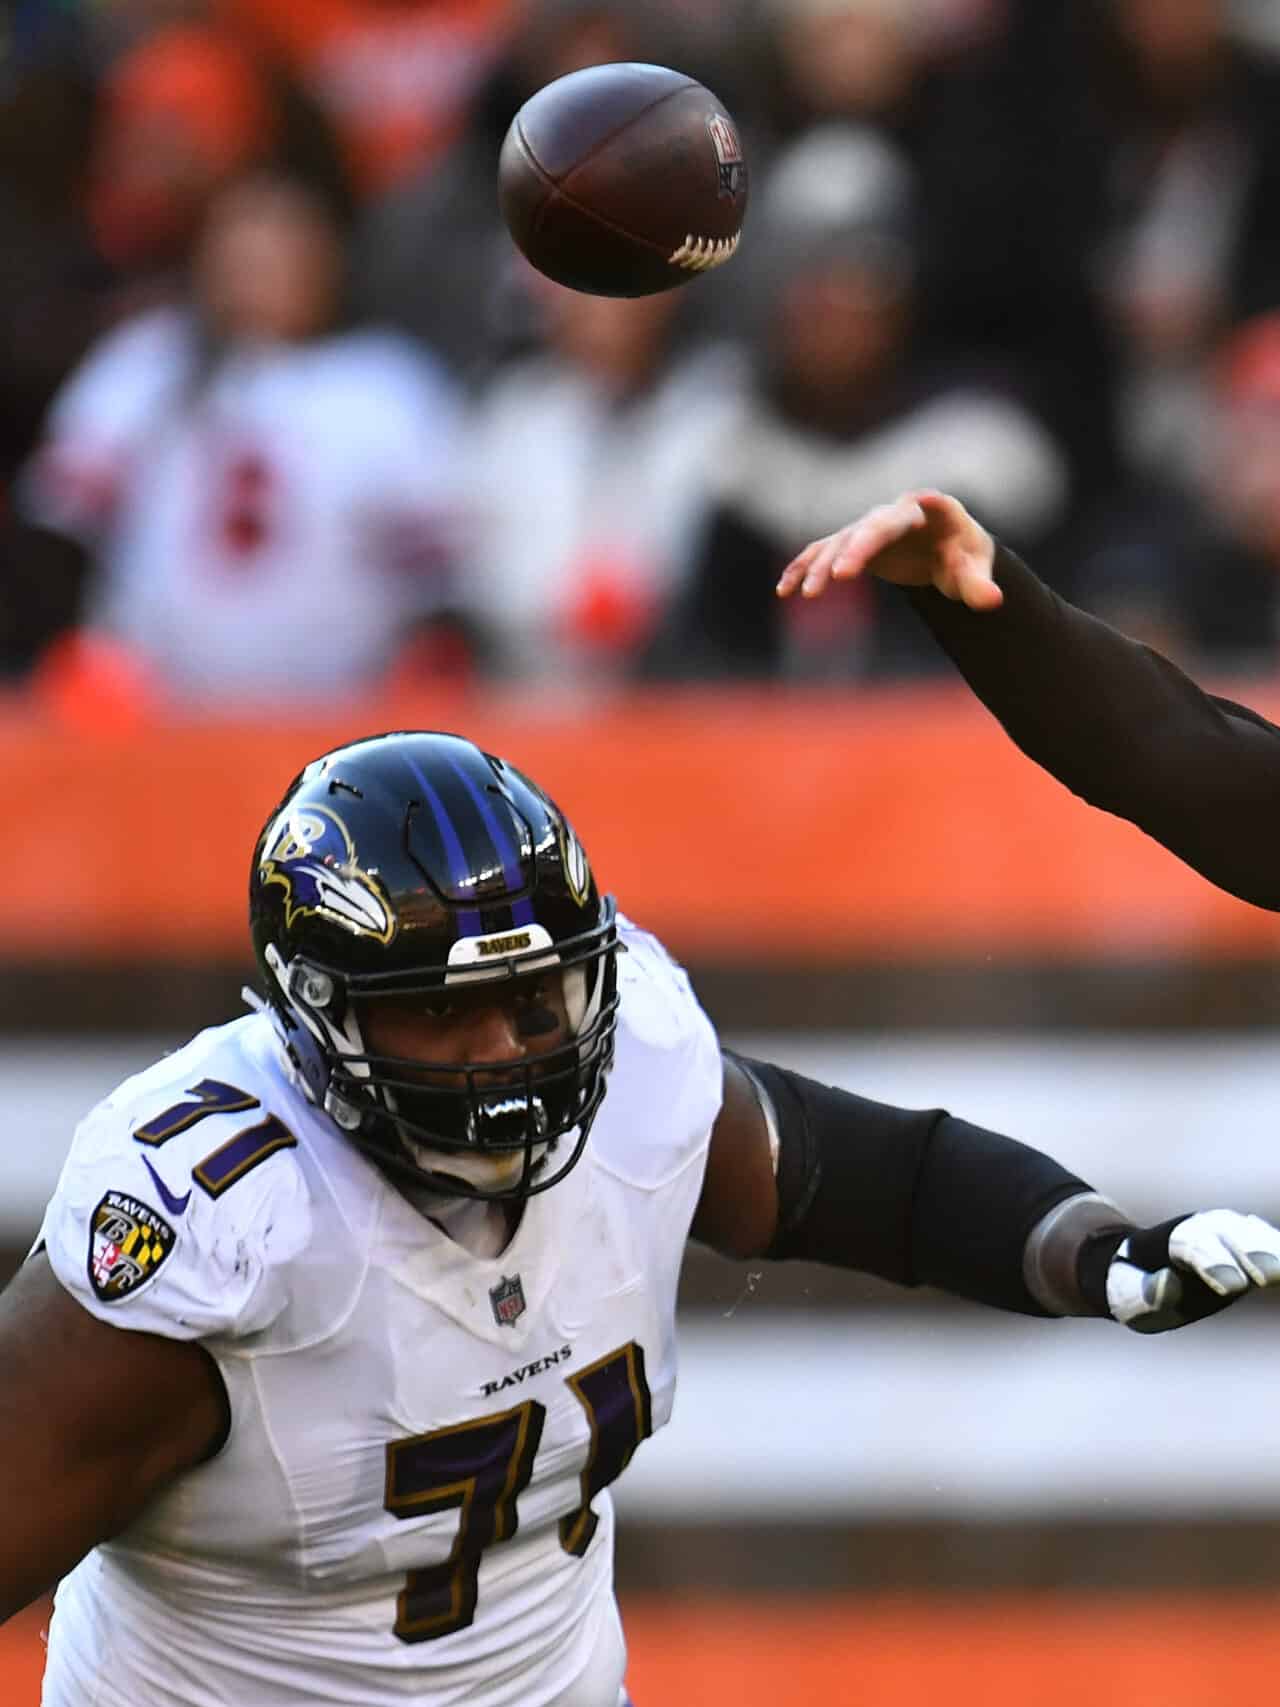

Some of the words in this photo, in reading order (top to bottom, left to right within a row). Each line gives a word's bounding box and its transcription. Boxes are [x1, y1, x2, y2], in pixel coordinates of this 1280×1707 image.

[476, 932, 531, 957] RAVENS
[132, 1078, 298, 1202] 71
[107, 1193, 170, 1240] RAVENS
[479, 1343, 573, 1397] RAVENS
[384, 1338, 653, 1645] 71
